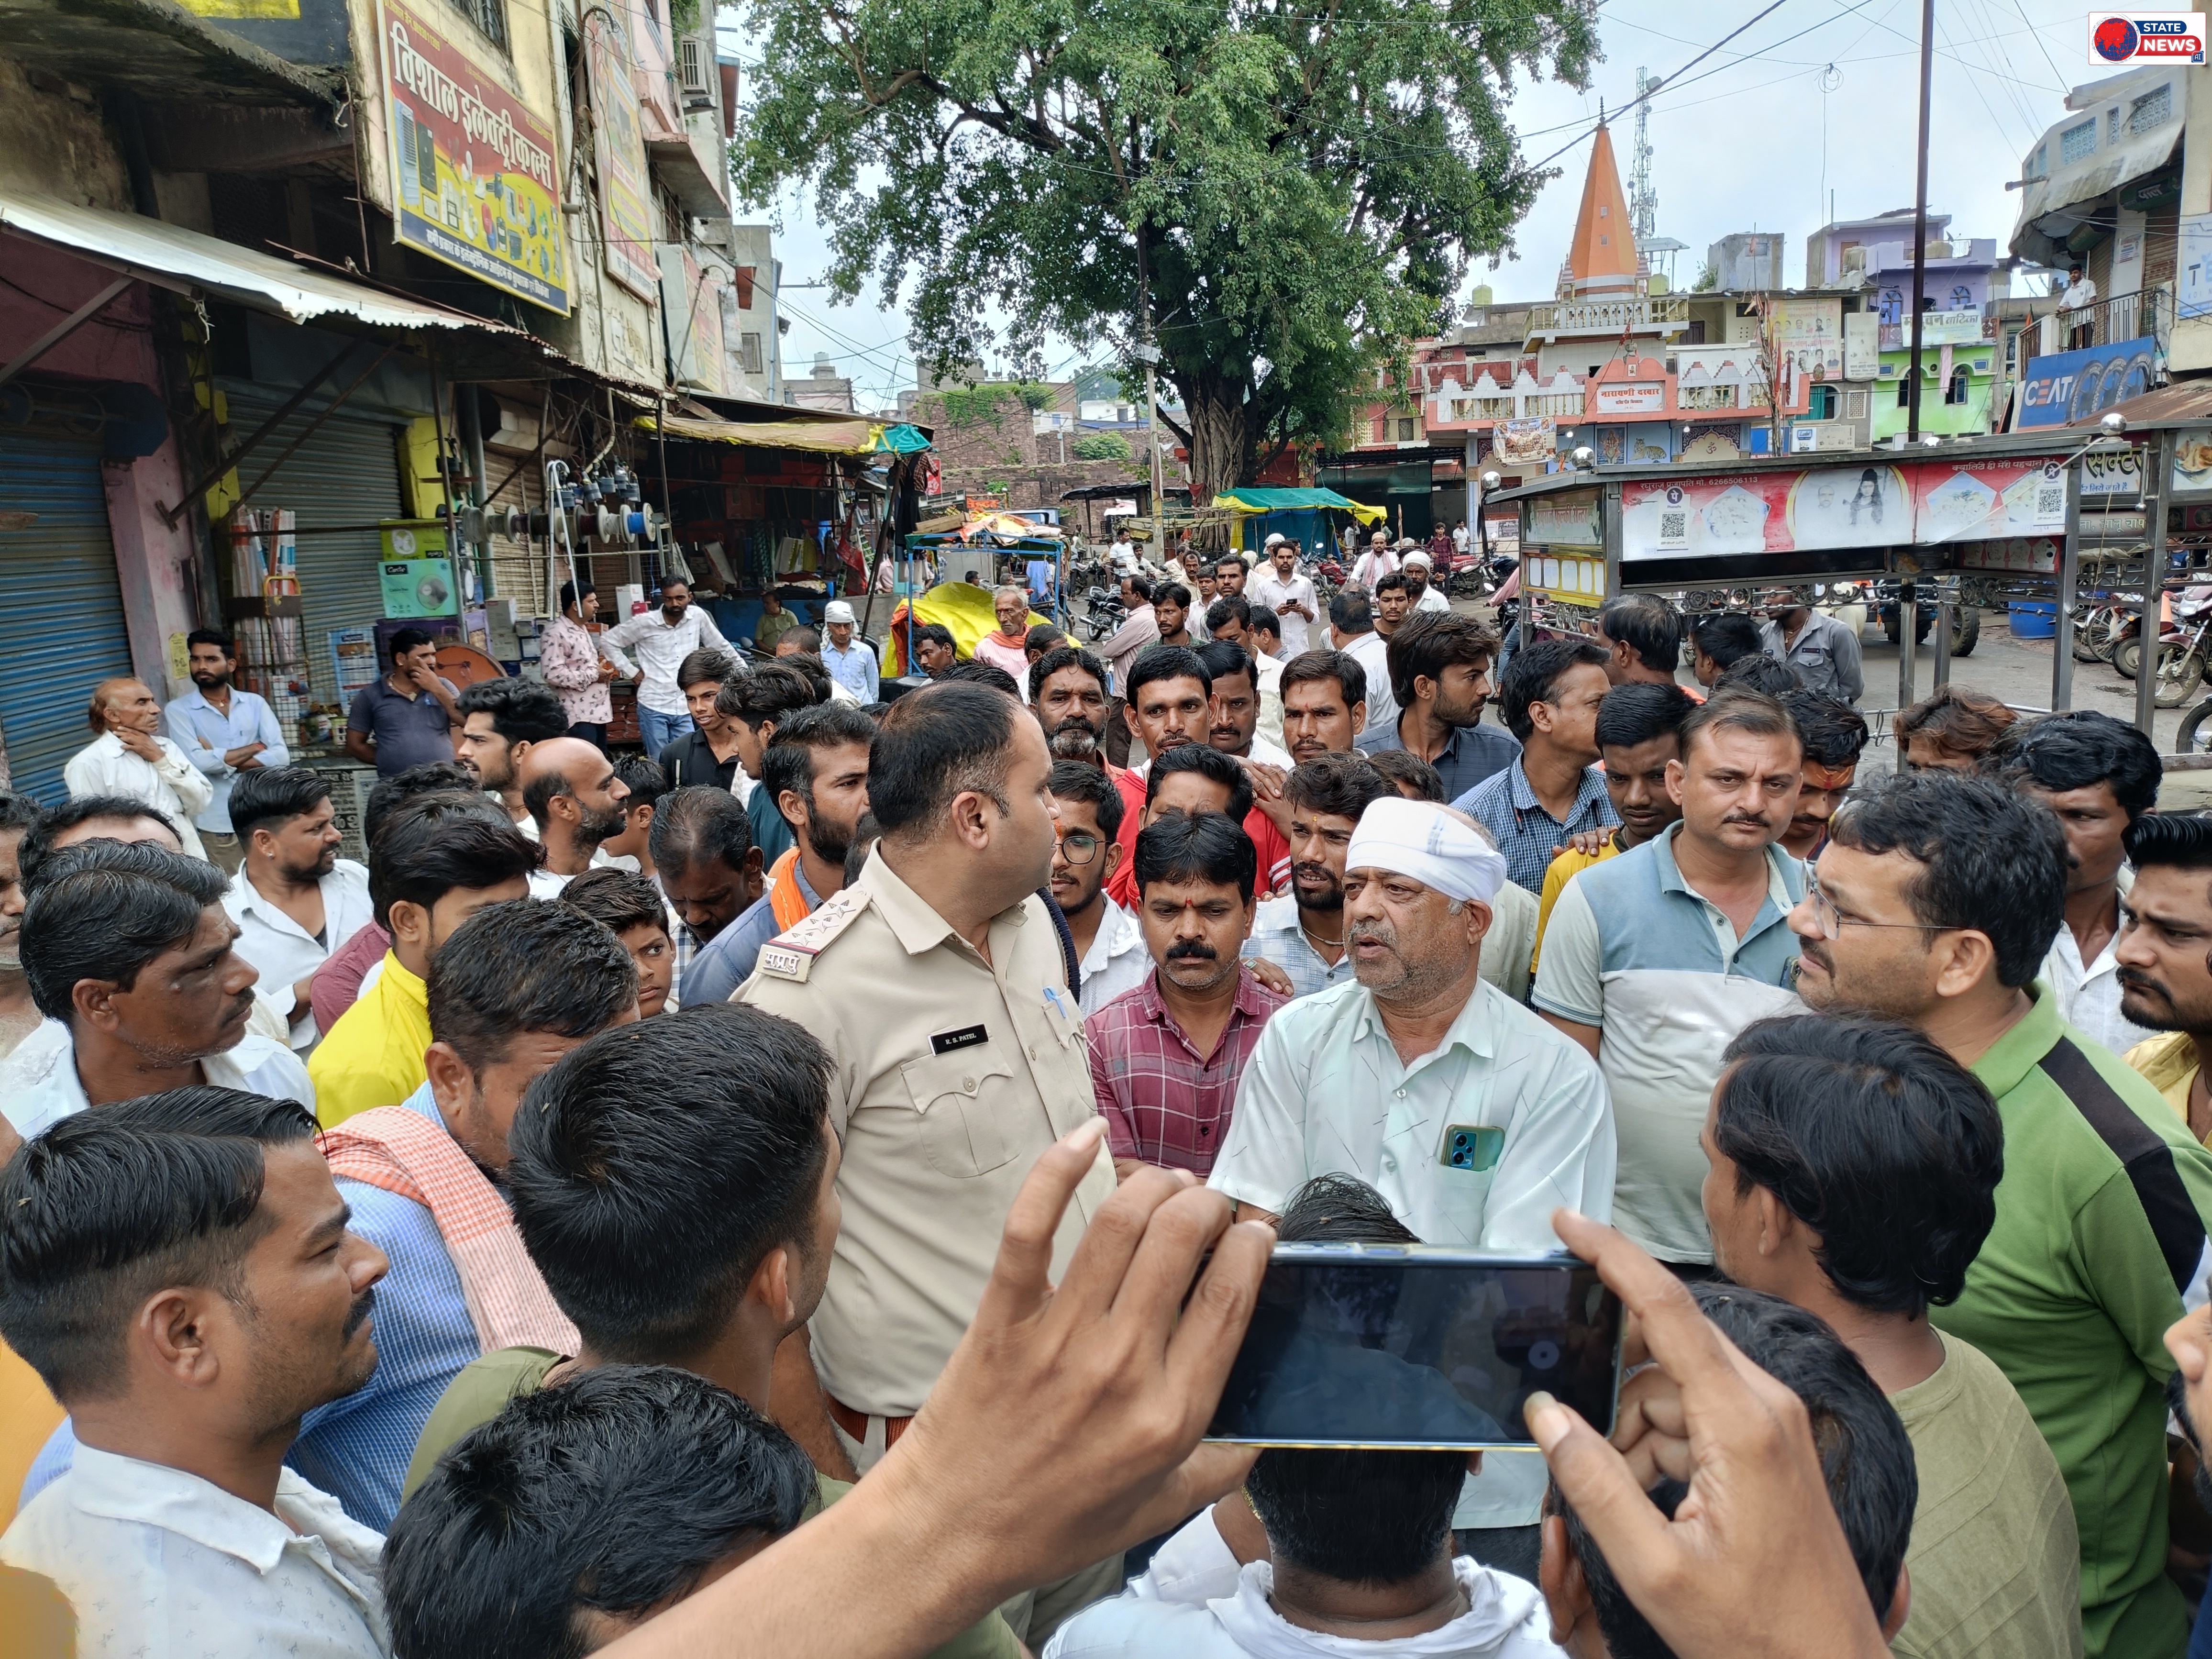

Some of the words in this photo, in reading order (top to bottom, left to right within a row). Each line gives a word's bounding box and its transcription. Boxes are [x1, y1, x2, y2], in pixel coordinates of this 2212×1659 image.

[390, 21, 459, 123] विशाल
[459, 85, 553, 191] इलेक्ट्रीकल्स
[1946, 313, 1979, 325] वाटिका
[1601, 388, 1635, 397] नारायणी
[2024, 376, 2073, 406] CEAT
[1952, 462, 1986, 471] क्वालिटी
[1987, 462, 1995, 470] ही
[2013, 459, 2042, 468] पहचान
[1640, 482, 1664, 491] रघुराज
[1666, 479, 1694, 488] प्रजापति
[1709, 476, 1758, 486] 6266506113
[2090, 483, 2104, 492] लिये
[2105, 482, 2120, 491] जाते
[1671, 490, 1679, 501] पे
[1554, 503, 1572, 530] फुल्की
[2099, 519, 2124, 532] आलू
[959, 1033, 977, 1041] PATEL
